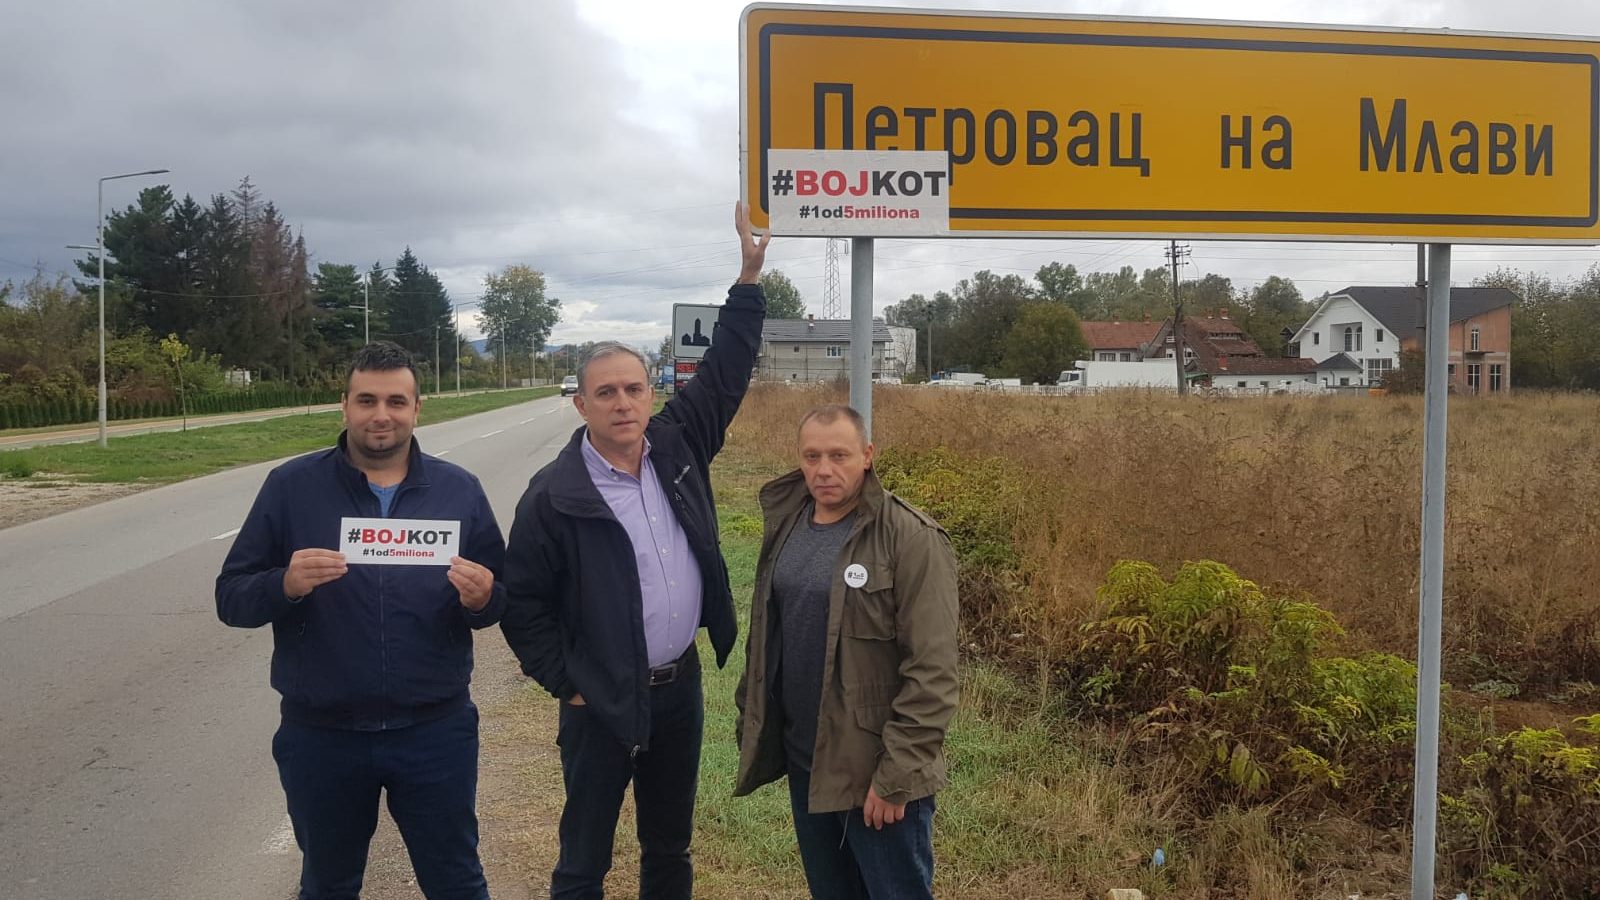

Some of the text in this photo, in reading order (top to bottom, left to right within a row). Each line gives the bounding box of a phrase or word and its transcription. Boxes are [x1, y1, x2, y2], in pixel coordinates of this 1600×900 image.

[814, 82, 1553, 186] Петровац на Млави
[772, 169, 946, 197] #BOJKOT
[799, 205, 920, 220] #1od5miliona
[348, 528, 452, 545] #BOJKOT
[362, 548, 435, 558] #1od5miliona
